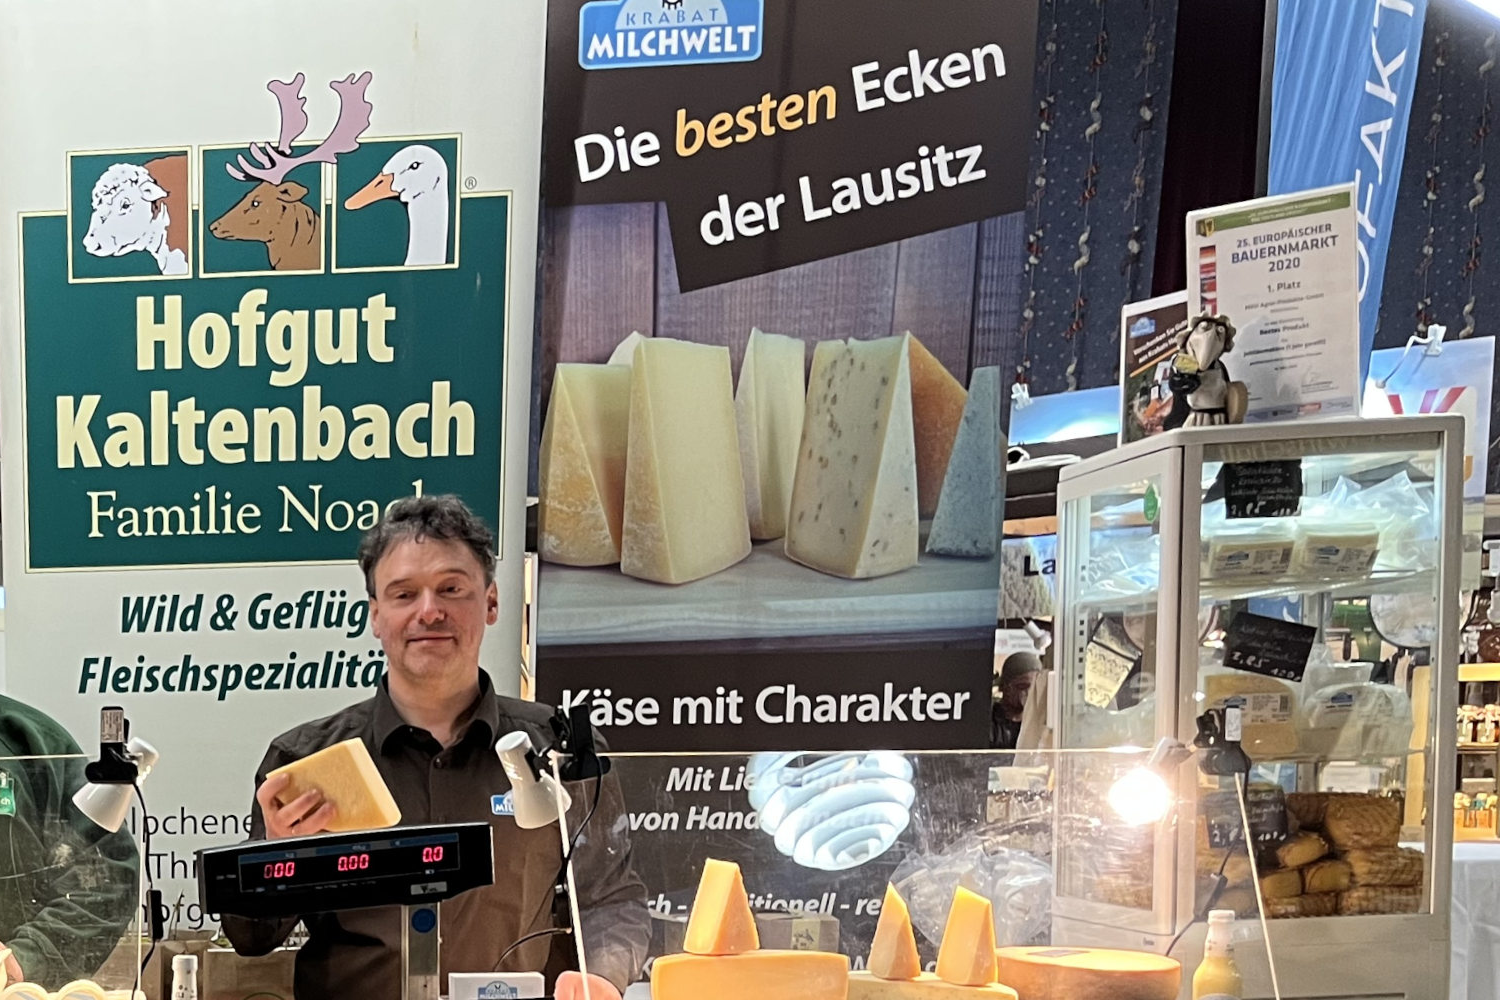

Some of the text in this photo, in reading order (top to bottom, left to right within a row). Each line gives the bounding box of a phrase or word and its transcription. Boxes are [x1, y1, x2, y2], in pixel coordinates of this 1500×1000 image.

[625, 6, 721, 26] KRABAT
[587, 25, 757, 60] MILCHWELT
[574, 43, 1007, 183] Die besten Ecken
[699, 144, 987, 246] der Lausitz
[1231, 235, 1339, 264] BAUERNMARKT
[1253, 223, 1332, 245] EUROPÄISCHER
[1268, 257, 1301, 272] 2020
[1277, 281, 1301, 292] Platz
[136, 289, 396, 387] Hofgut
[56, 381, 475, 469] Kaltenbach
[86, 485, 262, 538] Familie
[1024, 556, 1056, 576] La
[120, 590, 370, 638] Wild & Geflüg
[78, 650, 386, 701] Fleischspezialitä
[673, 687, 743, 725] mit
[755, 683, 970, 723] Charakter
[665, 766, 757, 792] Mit Lie
[629, 812, 680, 831] von
[749, 893, 837, 916] itionell
[855, 899, 884, 916] re
